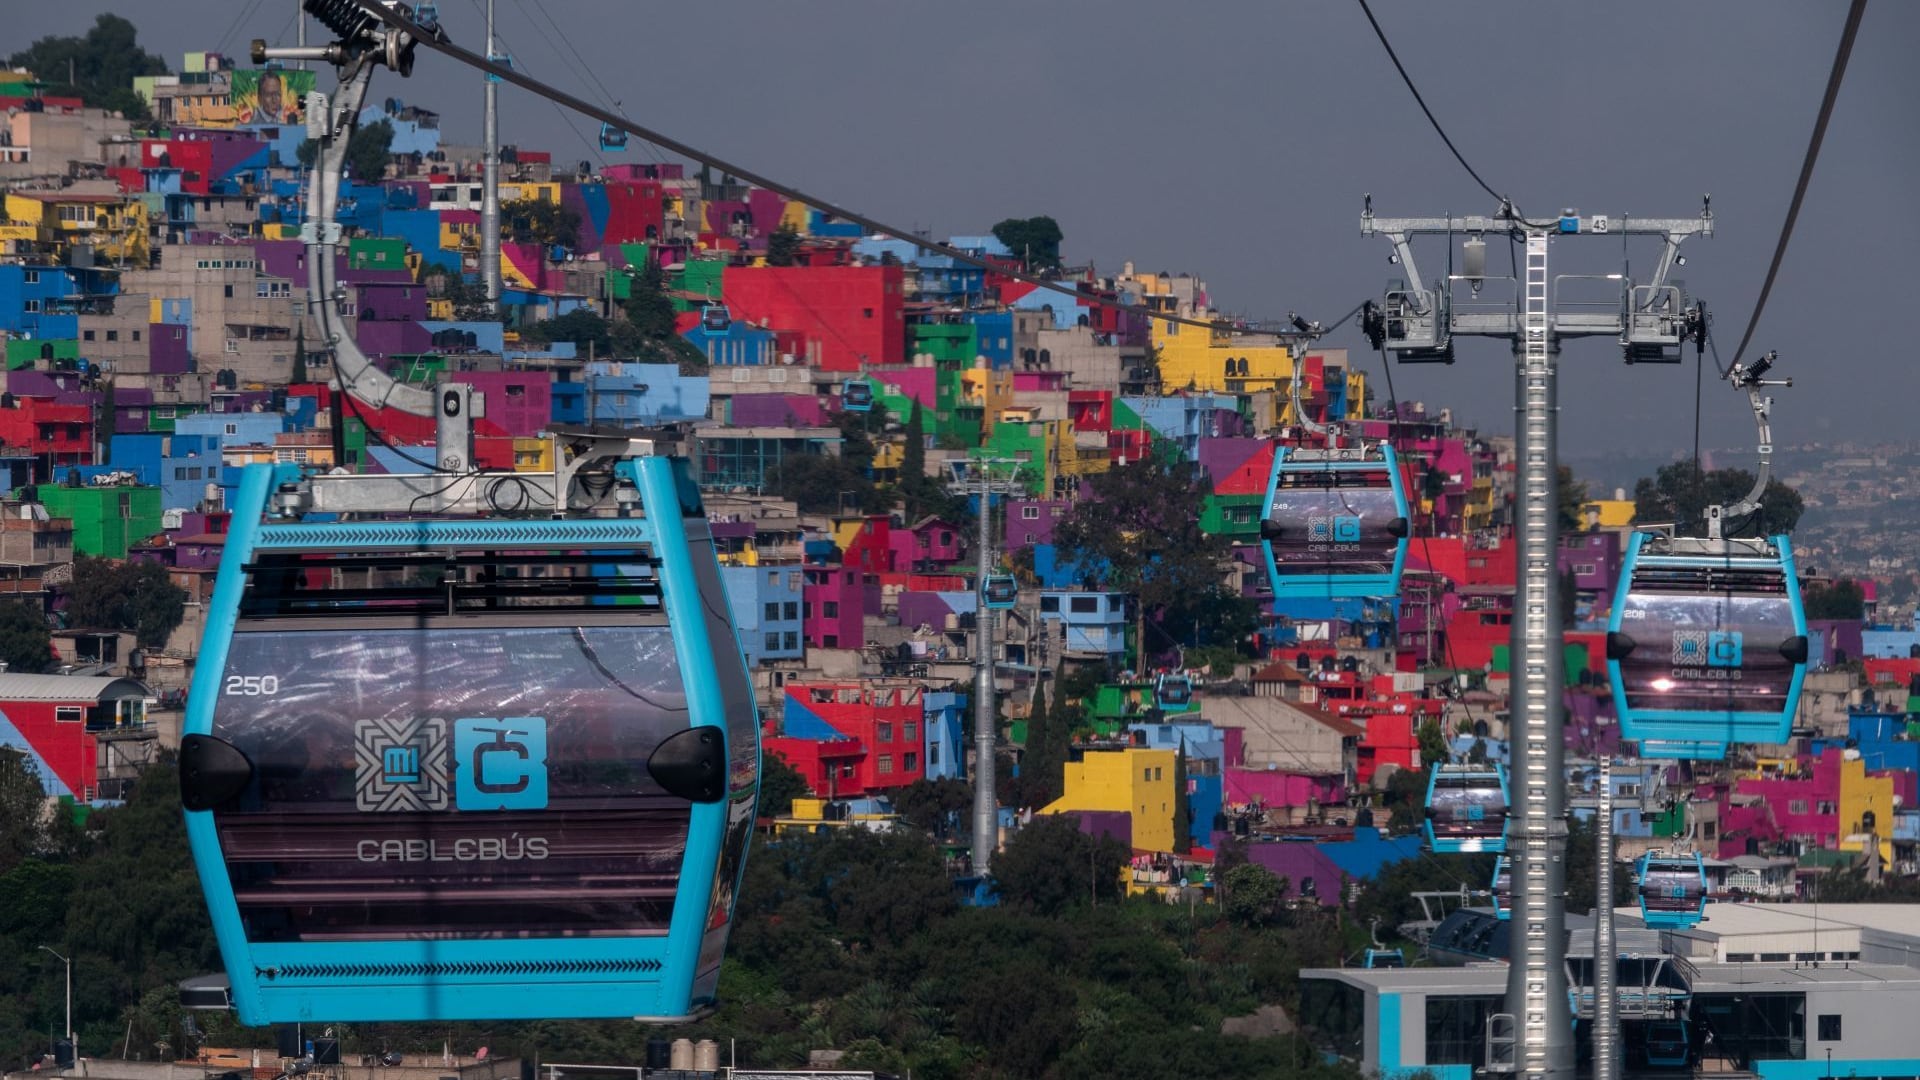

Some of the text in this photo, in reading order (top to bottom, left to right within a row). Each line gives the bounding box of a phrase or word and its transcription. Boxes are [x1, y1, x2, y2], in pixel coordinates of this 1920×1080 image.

[1593, 219, 1607, 231] 43
[226, 675, 279, 695] 250
[357, 832, 550, 862] CABLEBÚS
